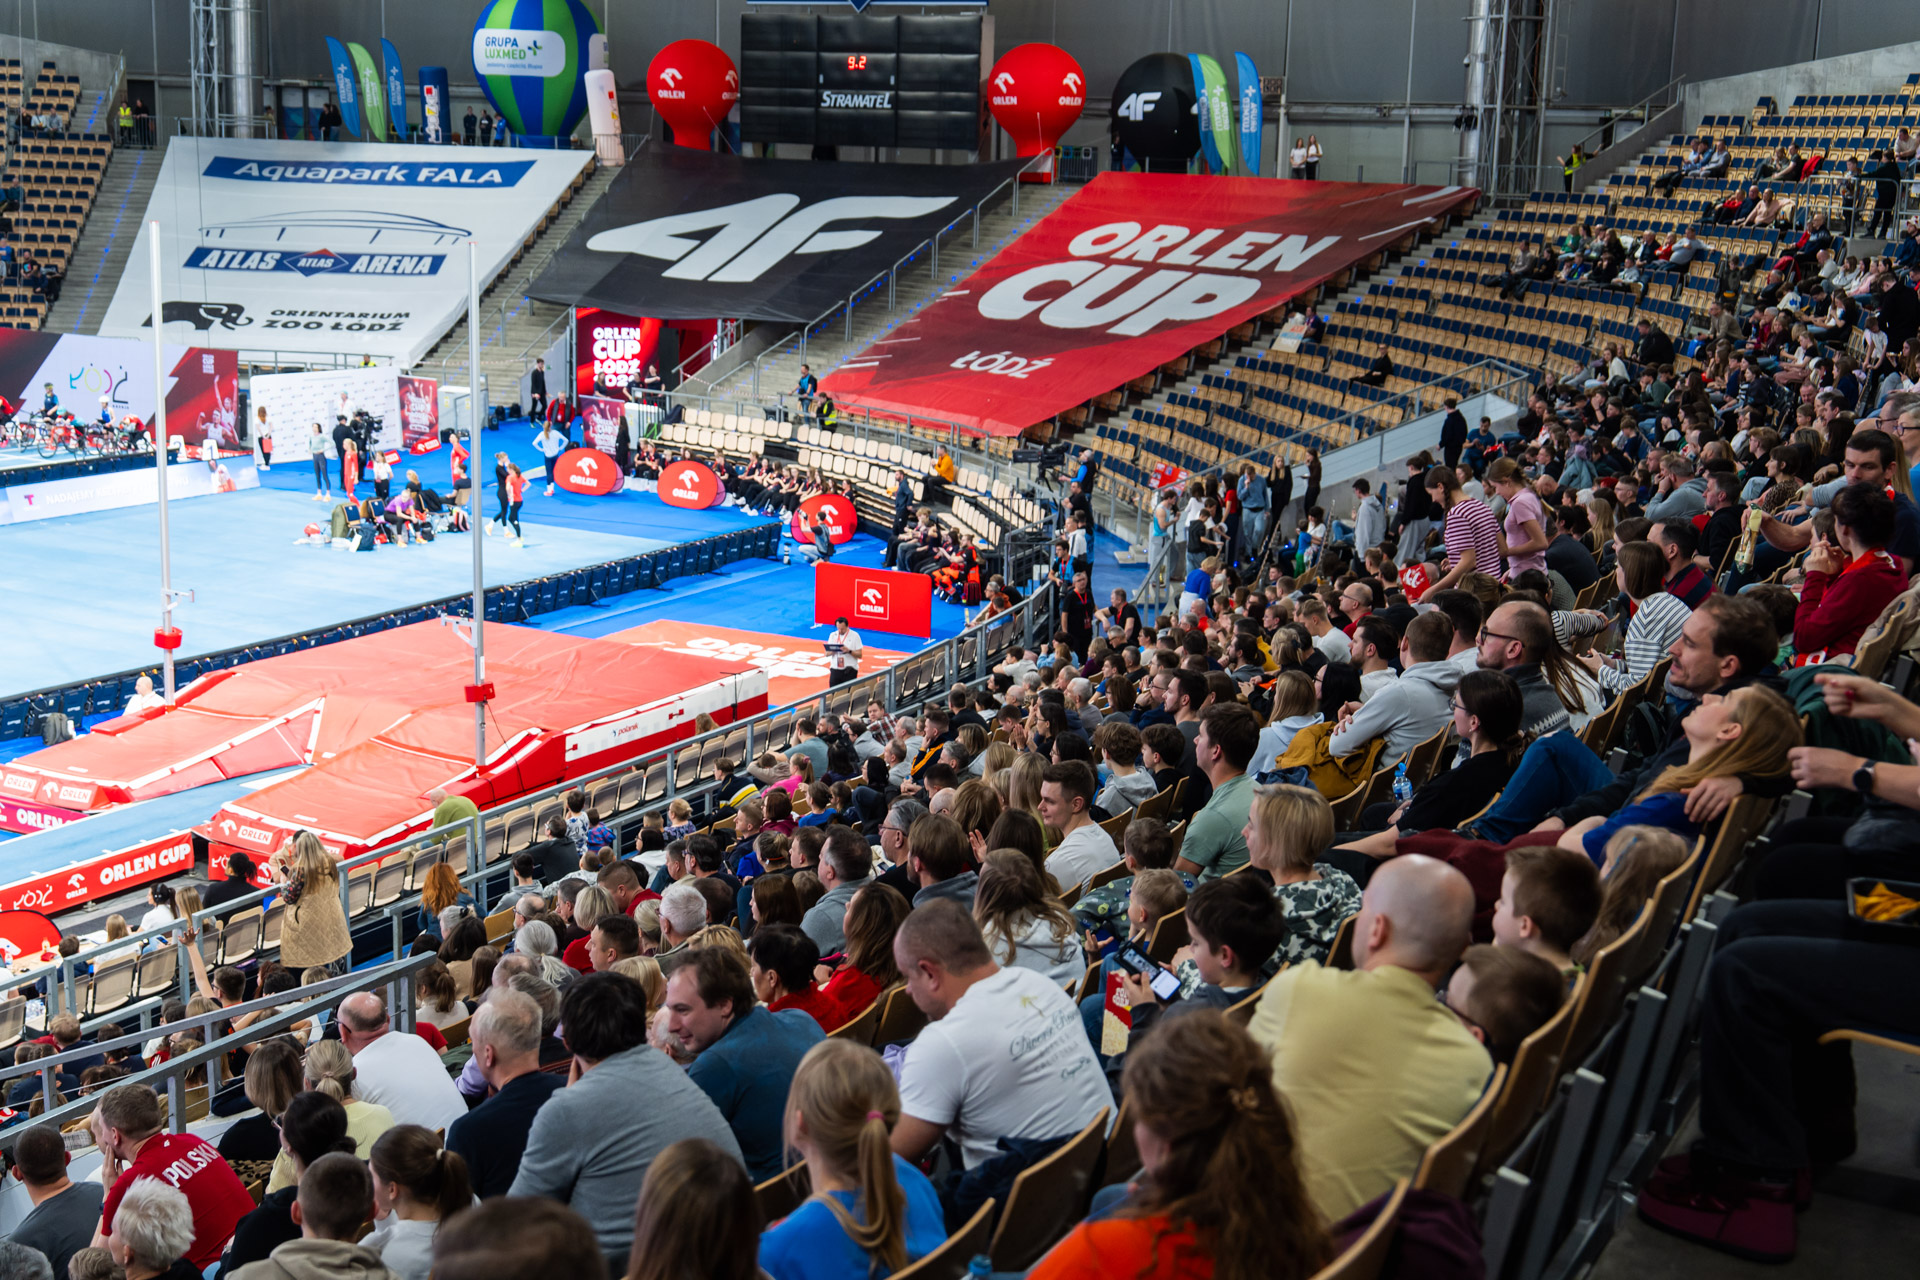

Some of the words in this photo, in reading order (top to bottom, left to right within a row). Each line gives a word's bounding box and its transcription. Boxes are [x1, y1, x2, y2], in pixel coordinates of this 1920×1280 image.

[485, 37, 518, 48] GRUPA
[485, 48, 526, 60] LUXMED
[847, 55, 867, 70] 9.2
[658, 90, 685, 100] ORLEN
[821, 91, 892, 109] STRAMATEL
[992, 96, 1018, 106] ORLEN
[1117, 92, 1162, 121] 4F
[234, 162, 409, 184] Aquapark
[417, 167, 503, 184] FALA
[586, 193, 959, 283] 4F
[1068, 221, 1343, 272] ORLEN
[199, 249, 281, 271] ATLAS
[297, 256, 334, 269] ATLAS
[349, 255, 433, 275] ARENA
[978, 260, 1262, 337] CUP
[270, 309, 410, 320] ORIENTARIUM
[262, 320, 324, 331] ZOO
[330, 319, 406, 332] ŁÓDŹ
[593, 327, 641, 341] ORLEN
[593, 340, 641, 360] CUP
[593, 358, 641, 374] ŁÓDŹ
[950, 350, 1055, 380] ŁÓDŹ
[569, 474, 597, 487] ORLEN
[672, 488, 699, 500] ORLEN
[860, 603, 884, 614] ORLEN
[7, 777, 33, 790] ORLEN
[62, 789, 89, 800] ORLEN
[16, 808, 63, 829] ORLEN
[241, 828, 270, 842] ORLEN
[66, 887, 88, 900] ORLEN
[100, 853, 157, 885] ORLEN
[158, 843, 191, 867] CUP
[162, 1142, 220, 1189] POLSKA
